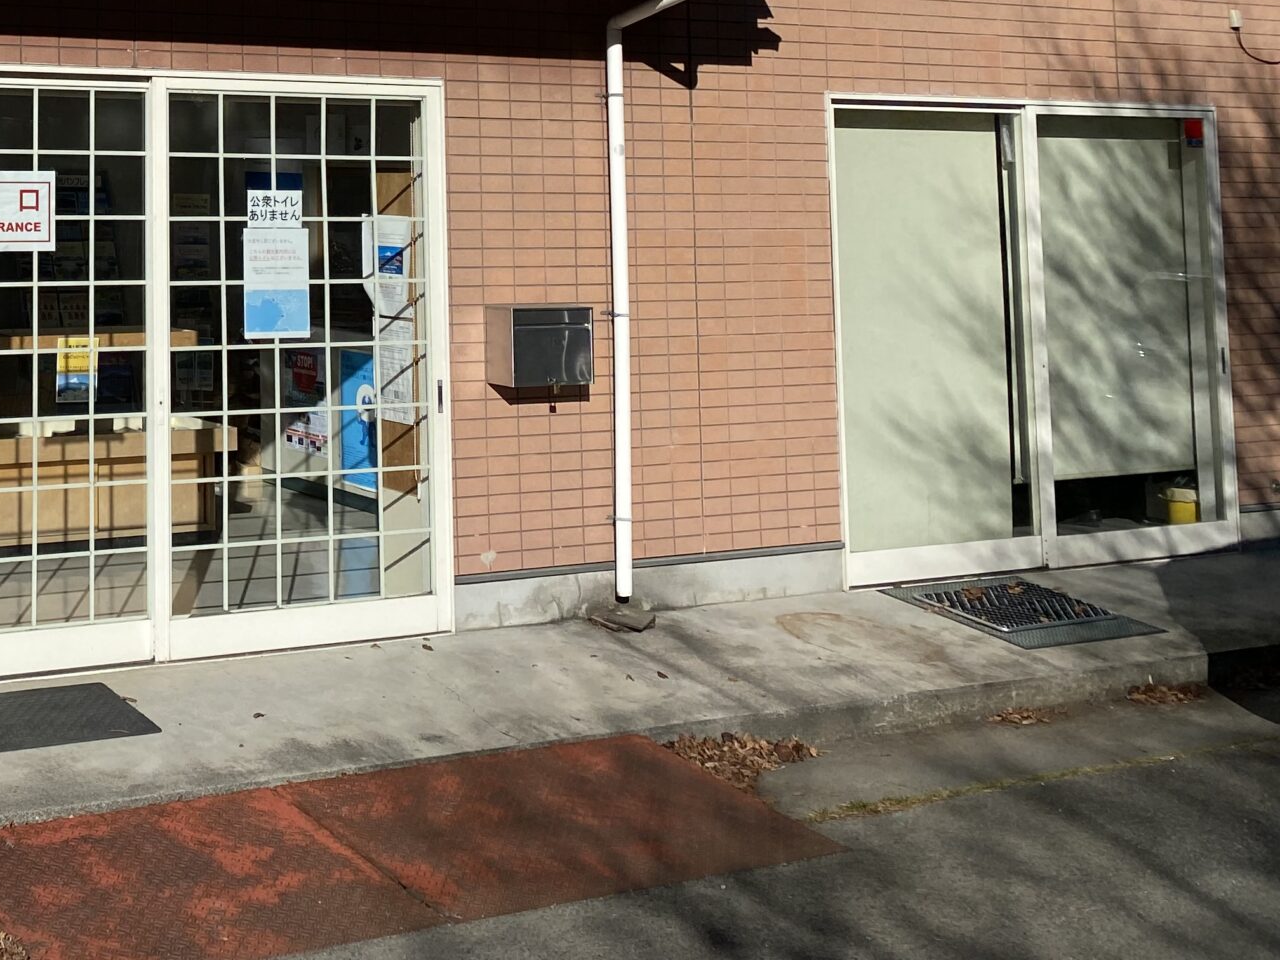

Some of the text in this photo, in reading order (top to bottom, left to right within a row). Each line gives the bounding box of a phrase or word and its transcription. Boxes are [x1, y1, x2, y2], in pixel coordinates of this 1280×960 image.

[250, 195, 299, 208] 公衆トイレ
[249, 209, 301, 222] ありません
